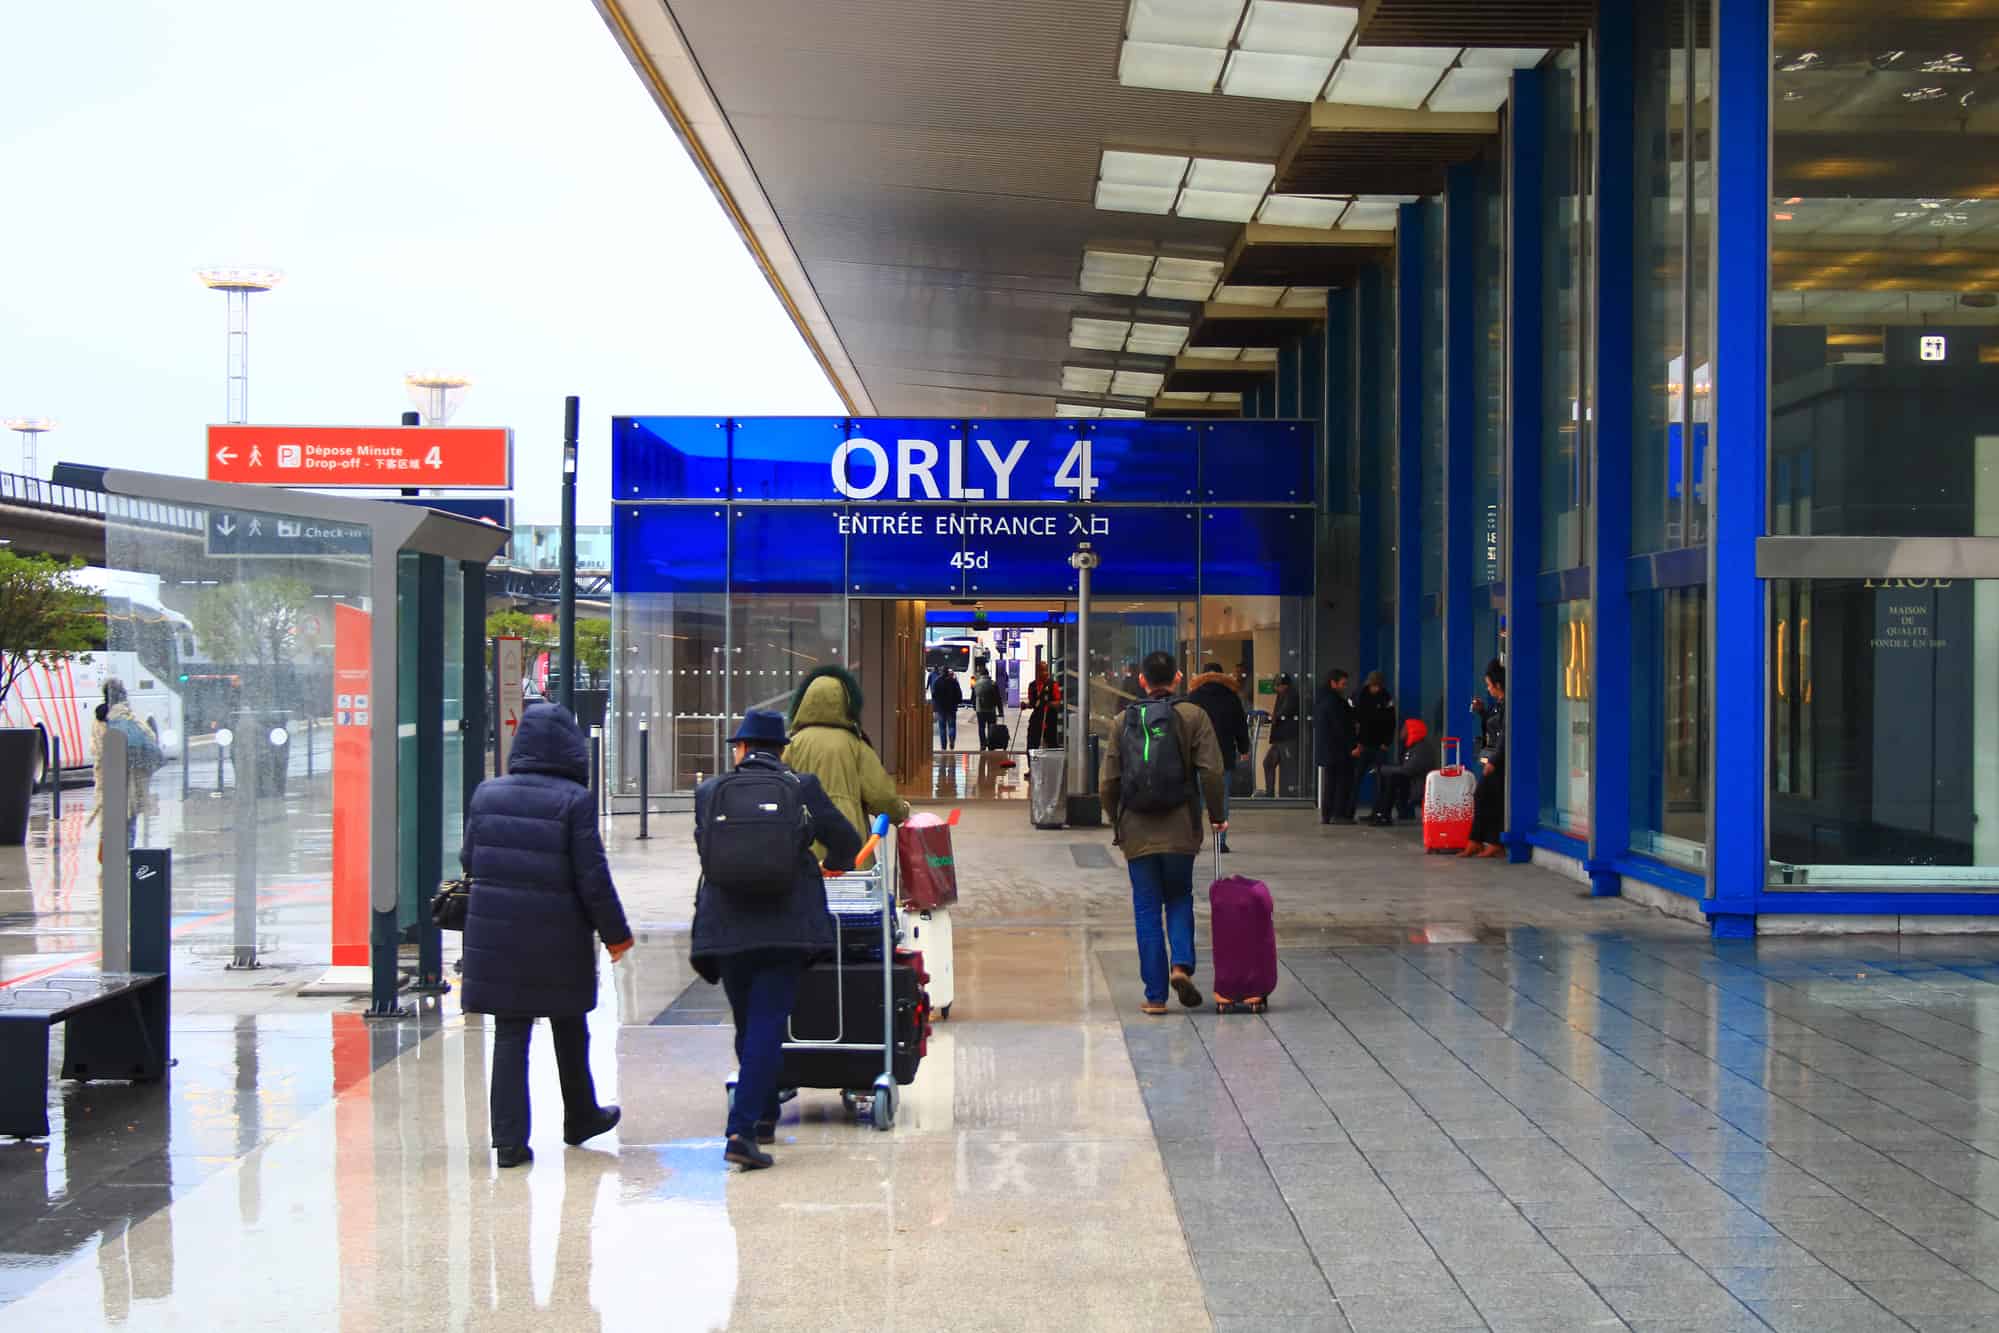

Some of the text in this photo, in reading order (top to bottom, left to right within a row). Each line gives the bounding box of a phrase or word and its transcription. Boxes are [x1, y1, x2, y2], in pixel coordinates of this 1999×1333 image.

[305, 444, 403, 457] Dépose Minute
[424, 446, 443, 469] 4
[305, 457, 361, 470] Drop-off
[831, 437, 1099, 500] ORLY 4
[305, 527, 362, 537] Check-in
[838, 512, 1109, 536] ENTRÉE ENTRANCE 入口
[950, 550, 989, 569] 45d
[1889, 606, 1927, 615] MAISON
